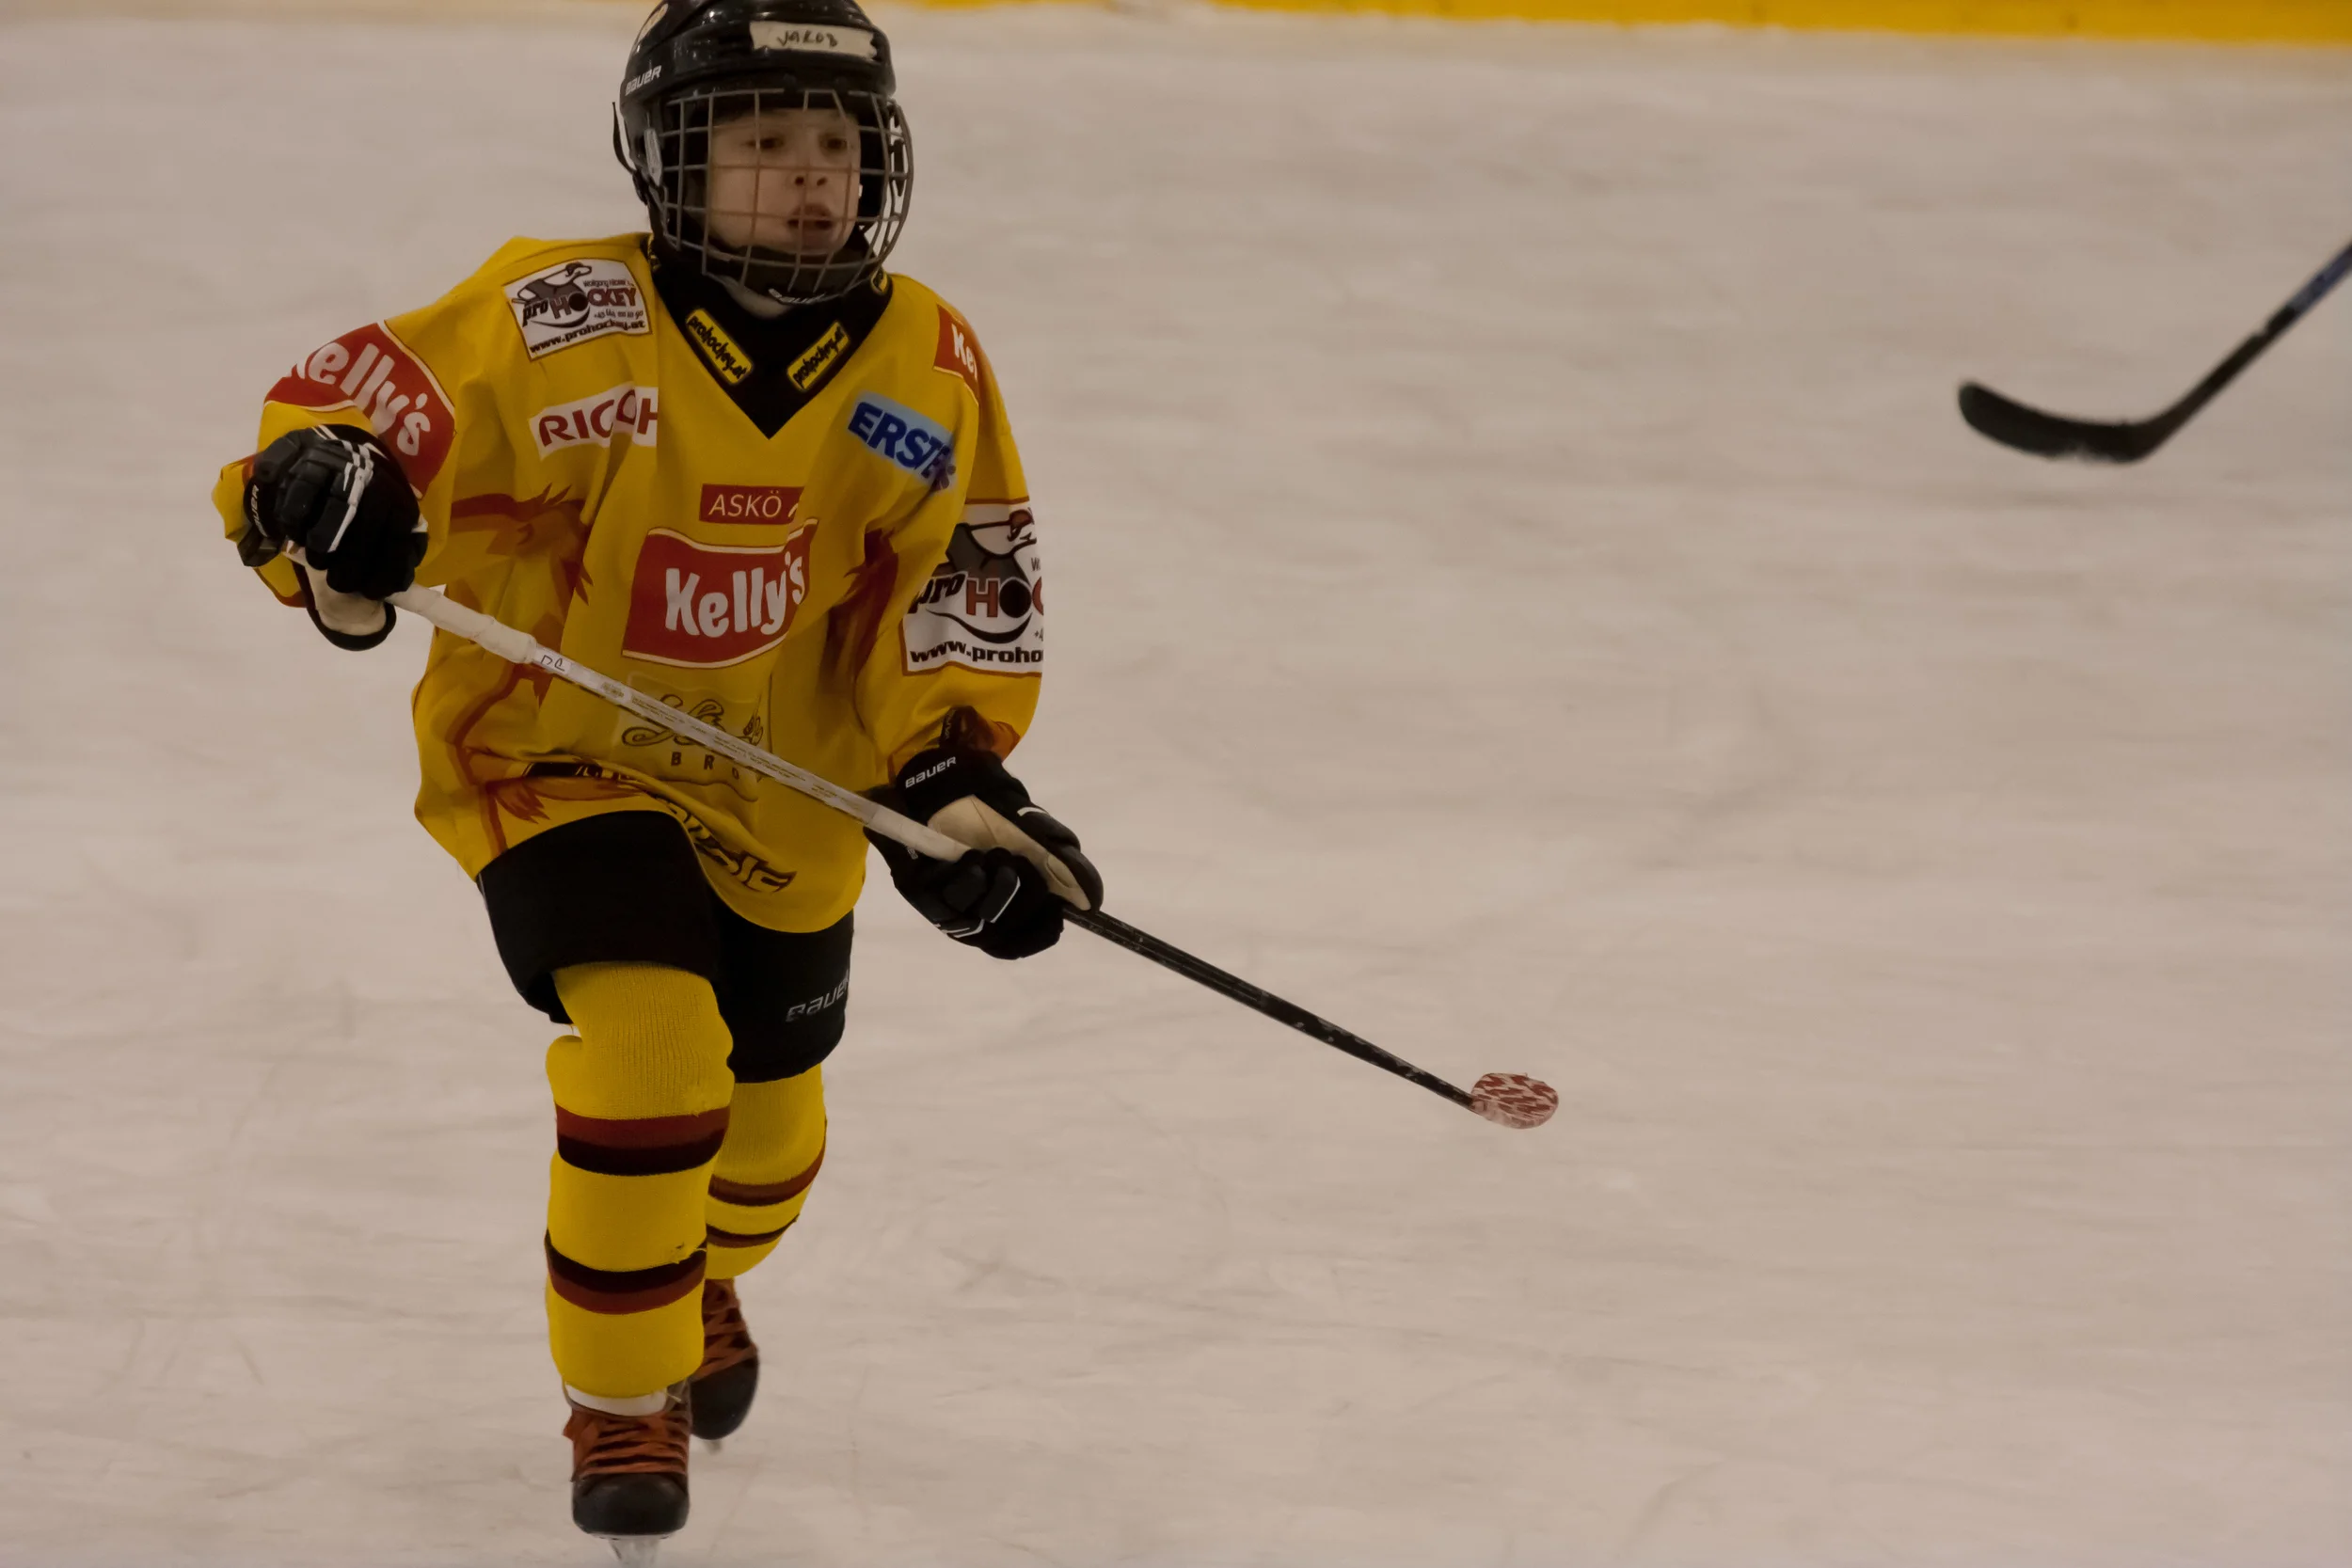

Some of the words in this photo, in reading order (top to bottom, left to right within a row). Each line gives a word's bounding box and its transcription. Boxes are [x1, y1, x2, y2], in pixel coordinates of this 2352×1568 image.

[625, 65, 662, 96] BAUER
[688, 316, 747, 379] prohockey.at
[792, 326, 846, 388] prohockey.at
[707, 489, 783, 518] ASKÖ
[664, 550, 805, 639] Kelly's
[905, 756, 957, 788] BAUER
